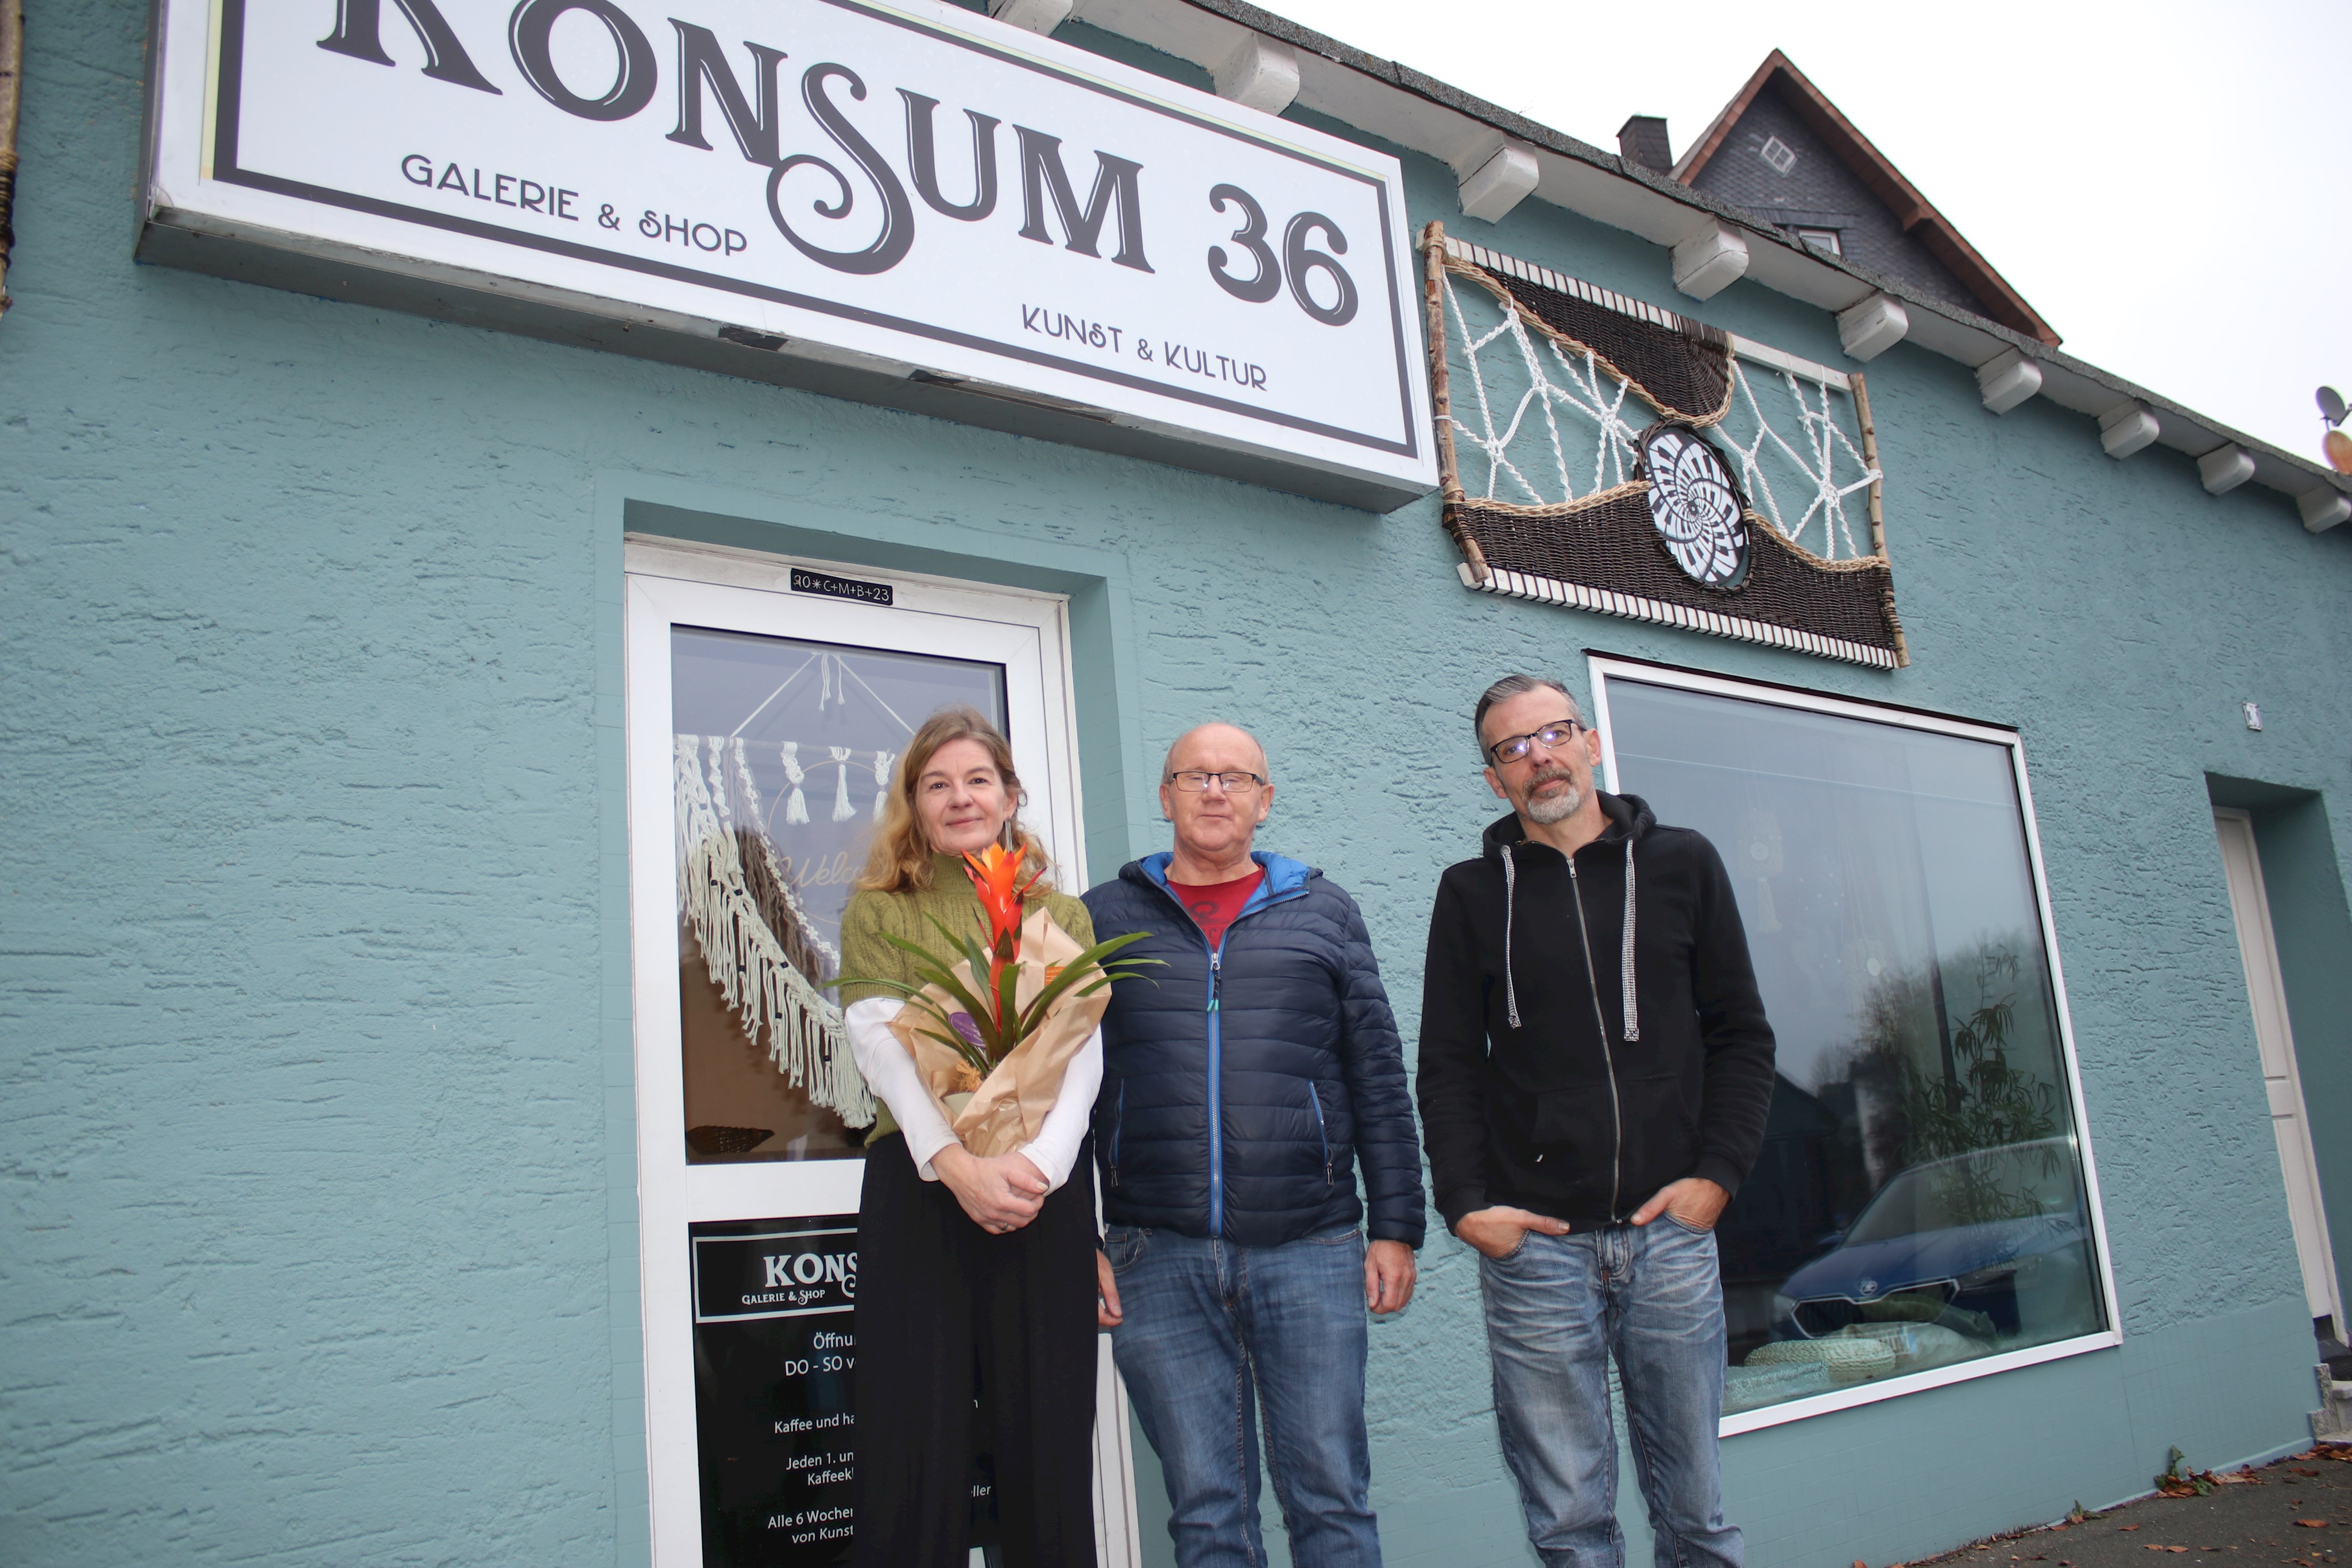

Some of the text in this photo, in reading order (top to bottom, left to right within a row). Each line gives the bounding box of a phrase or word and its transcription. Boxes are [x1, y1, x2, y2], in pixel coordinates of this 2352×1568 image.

[401, 154, 747, 256] GALERIE & SHOP
[1208, 183, 1359, 327] 36
[1022, 303, 1268, 392] KUNST & KULTUR
[788, 1291, 798, 1302] &
[813, 1331, 856, 1350] Öffnu
[785, 1359, 809, 1376] DO
[823, 1356, 843, 1372] SO
[846, 1357, 856, 1369] v
[775, 1418, 813, 1434] Kaffee
[816, 1414, 840, 1428] und
[786, 1455, 822, 1470] Jeden
[826, 1453, 836, 1464] 1.
[767, 1514, 793, 1530] Alle
[796, 1512, 804, 1526] 6
[971, 1485, 991, 1497] ller
[792, 1531, 816, 1544] von
